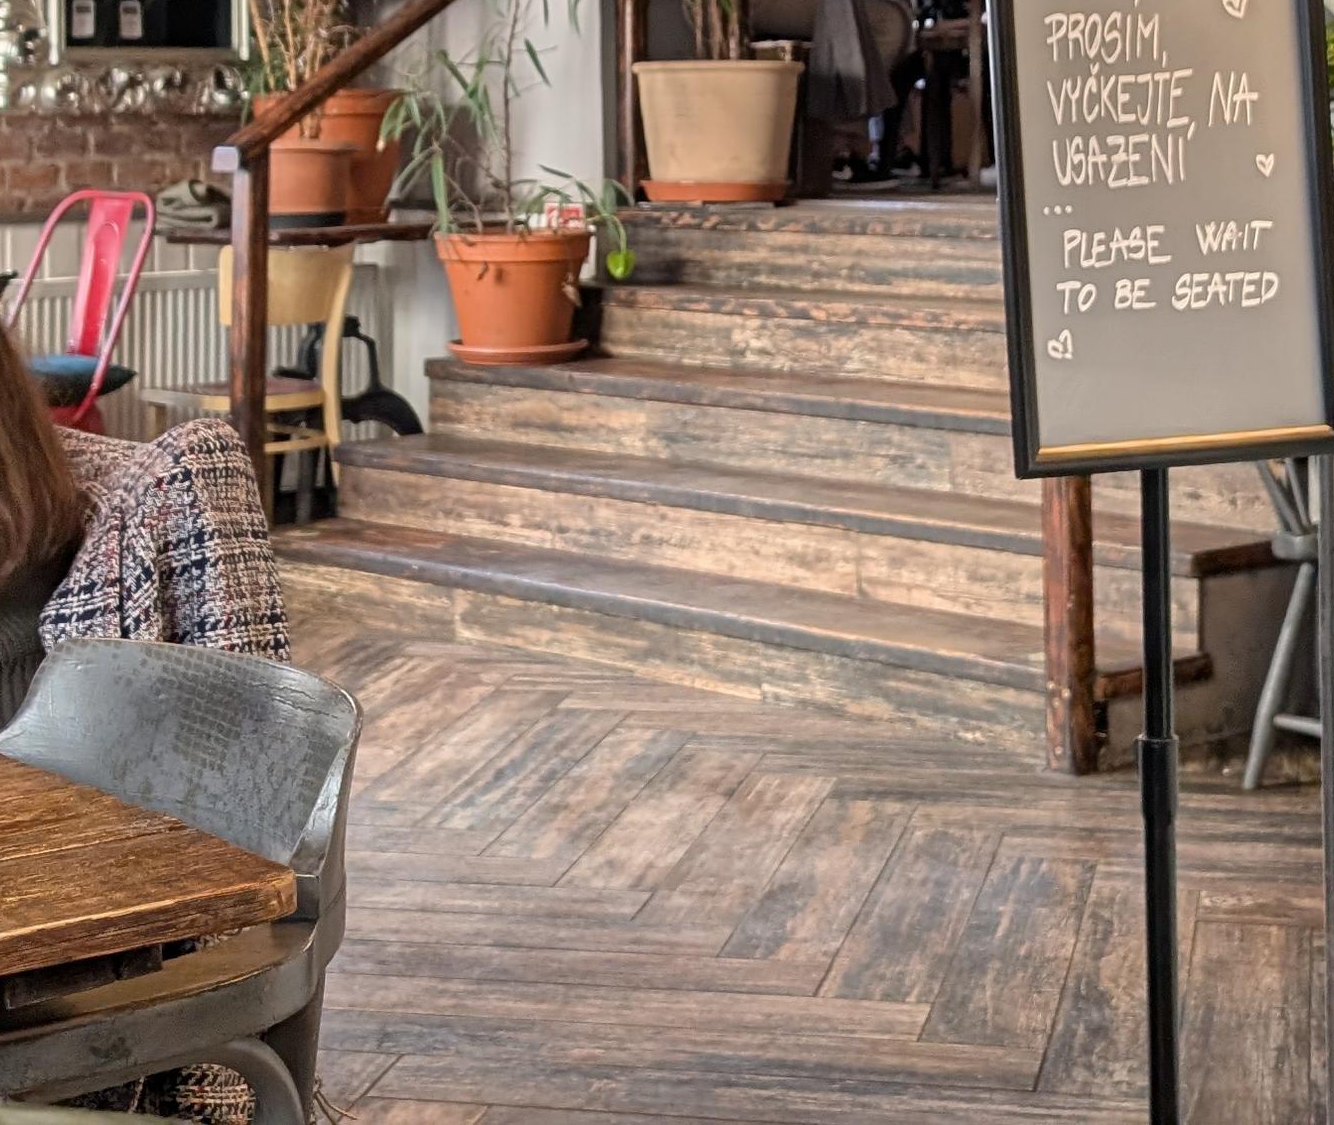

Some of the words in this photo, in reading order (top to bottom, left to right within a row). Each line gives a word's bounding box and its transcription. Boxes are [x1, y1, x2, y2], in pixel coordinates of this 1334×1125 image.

[1047, 62, 1193, 127] VYČKEJTE
[1208, 71, 1259, 127] NA
[1052, 122, 1196, 189] USAZENÍ
[1063, 225, 1172, 268] PLEASE
[1195, 219, 1274, 255] WAIT
[1056, 280, 1097, 314] TO
[1114, 278, 1157, 310] BE
[1171, 271, 1279, 311] SEATED
